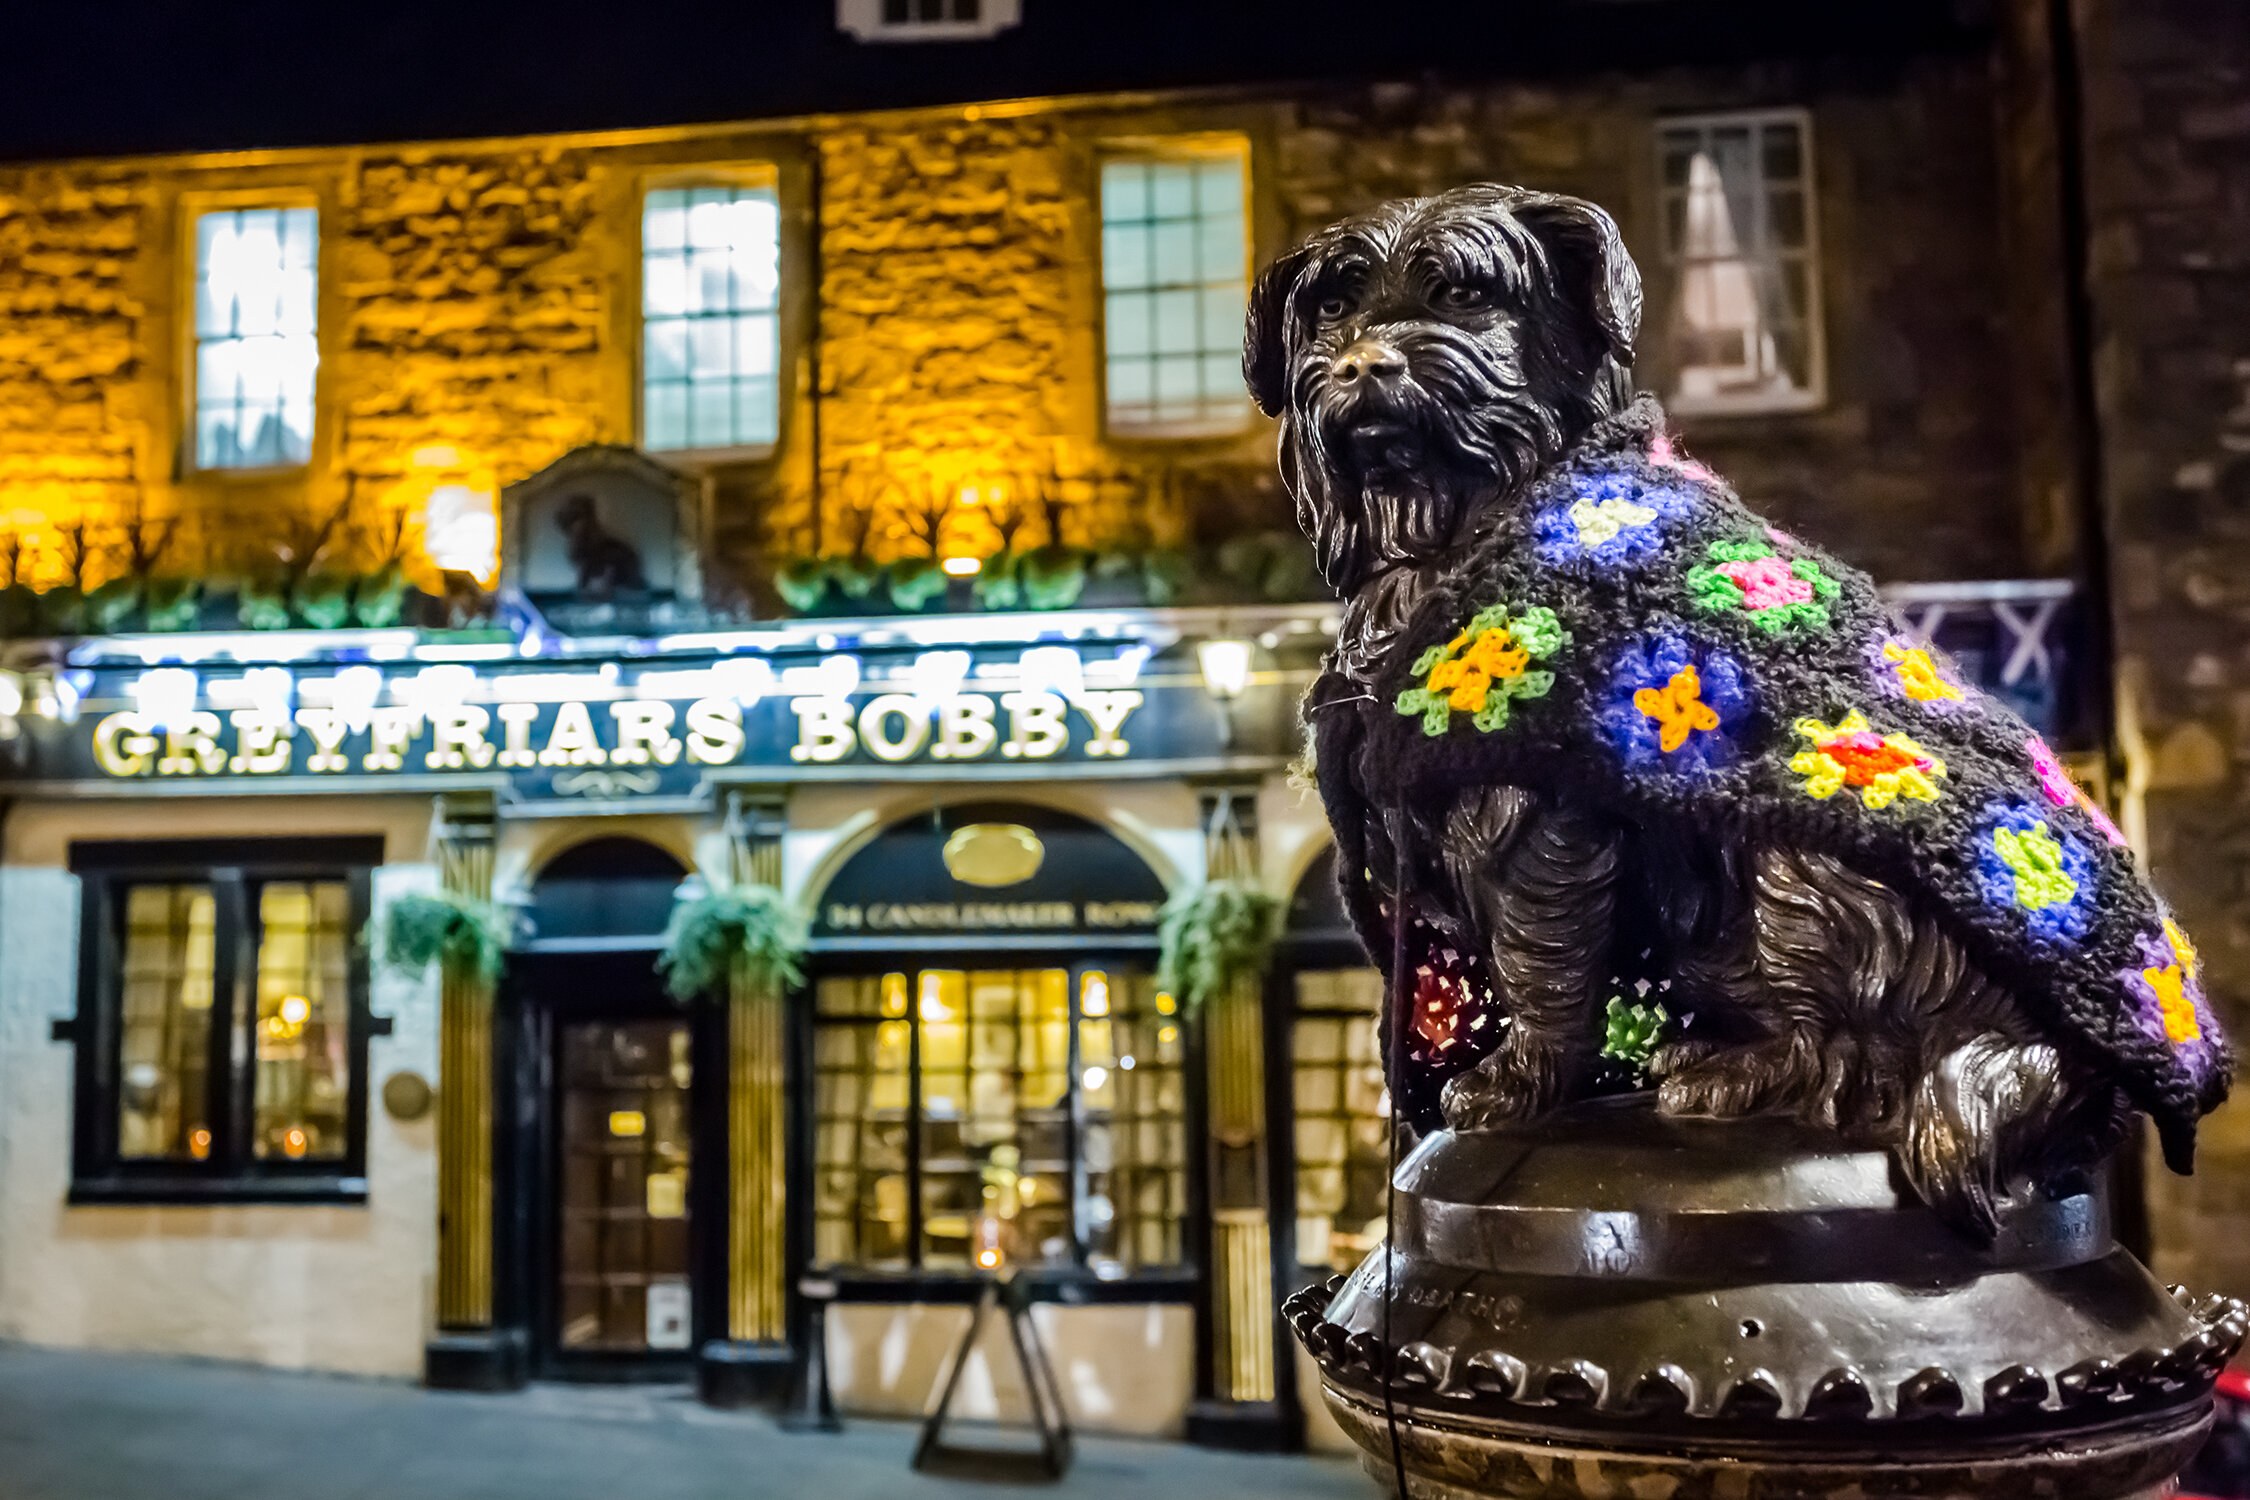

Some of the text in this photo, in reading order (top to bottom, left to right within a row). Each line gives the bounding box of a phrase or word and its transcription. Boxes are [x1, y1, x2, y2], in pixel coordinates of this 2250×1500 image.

[93, 691, 1143, 777] GREYFRIARS BOBBY
[1083, 900, 1159, 928] ROW
